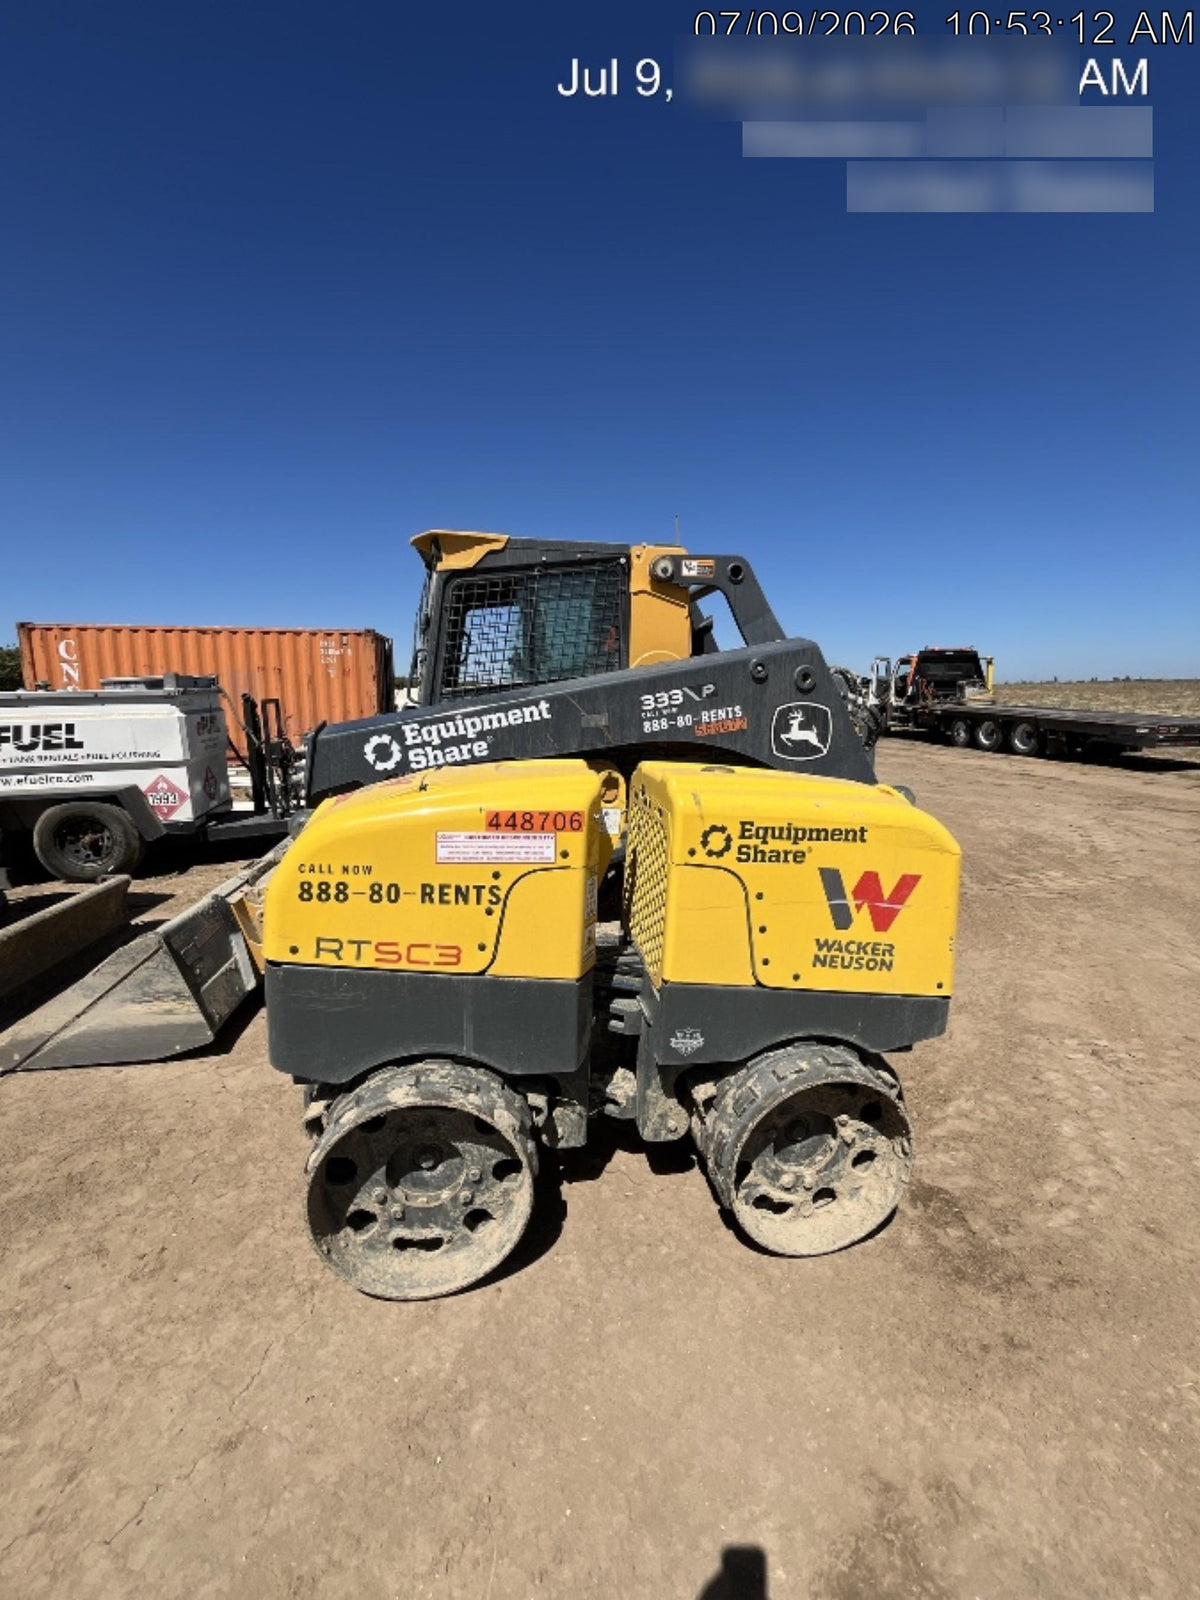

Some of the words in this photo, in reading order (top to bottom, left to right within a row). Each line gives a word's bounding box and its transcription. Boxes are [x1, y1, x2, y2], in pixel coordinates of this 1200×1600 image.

[640, 689, 684, 710] 333
[402, 700, 551, 746] Equipment
[643, 705, 743, 733] 888-80-RENTS
[408, 740, 489, 769] Share
[488, 812, 583, 831] 448706
[738, 821, 868, 844] Equipment
[735, 844, 807, 864] Share
[298, 864, 334, 875] CALL
[342, 866, 373, 876] NOW
[298, 881, 502, 906] 888-80-RENTS
[314, 937, 463, 966] RTSC3
[814, 938, 896, 957] WACKER
[811, 953, 894, 972] NEUSON
